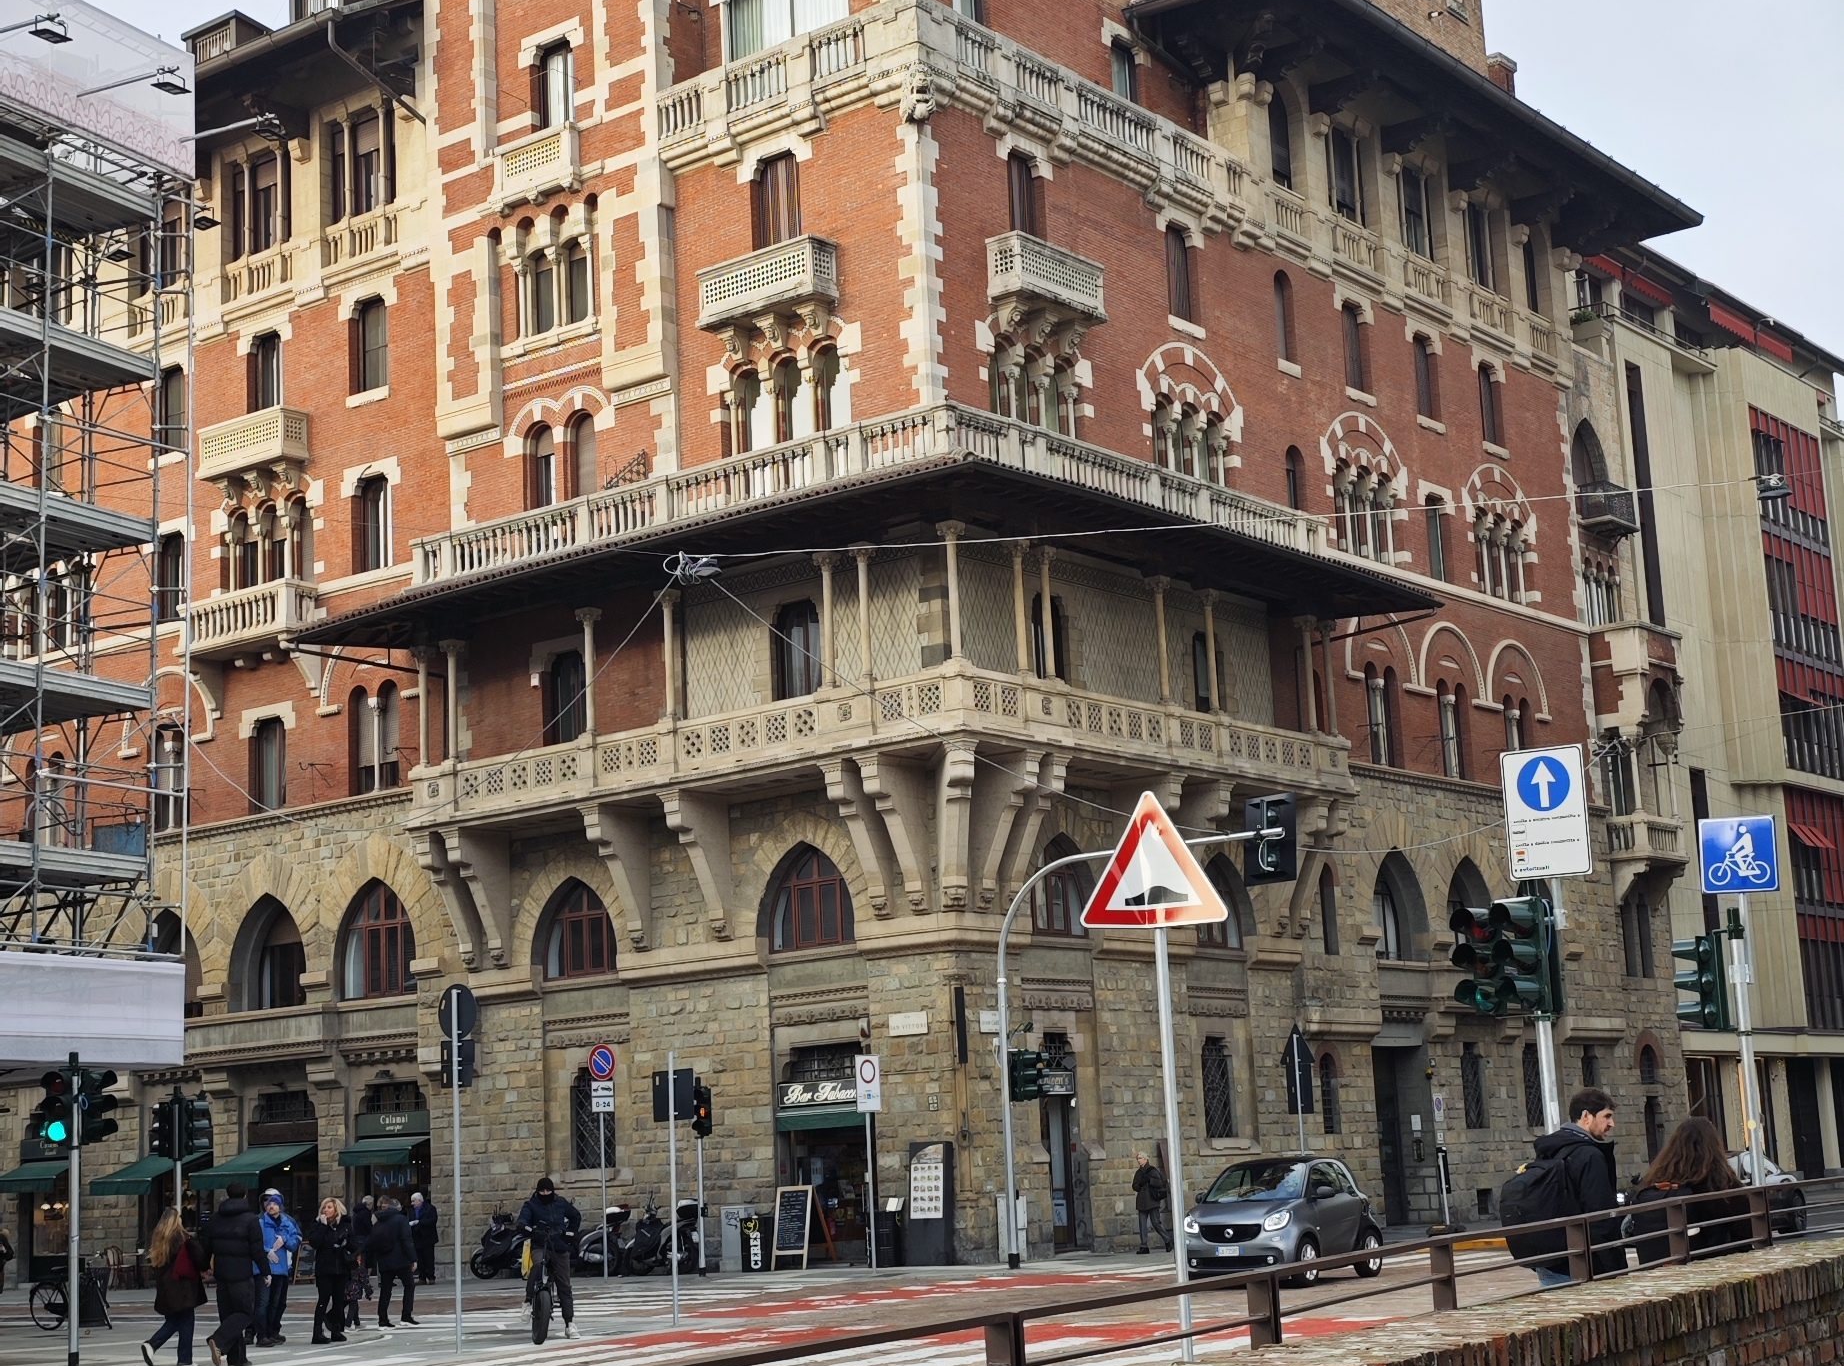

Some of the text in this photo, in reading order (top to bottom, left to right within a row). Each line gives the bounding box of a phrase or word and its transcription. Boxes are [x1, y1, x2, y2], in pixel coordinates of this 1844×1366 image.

[783, 1084, 812, 1105] Bar
[374, 1169, 412, 1188] SALDI
[749, 1231, 762, 1269] CERES
